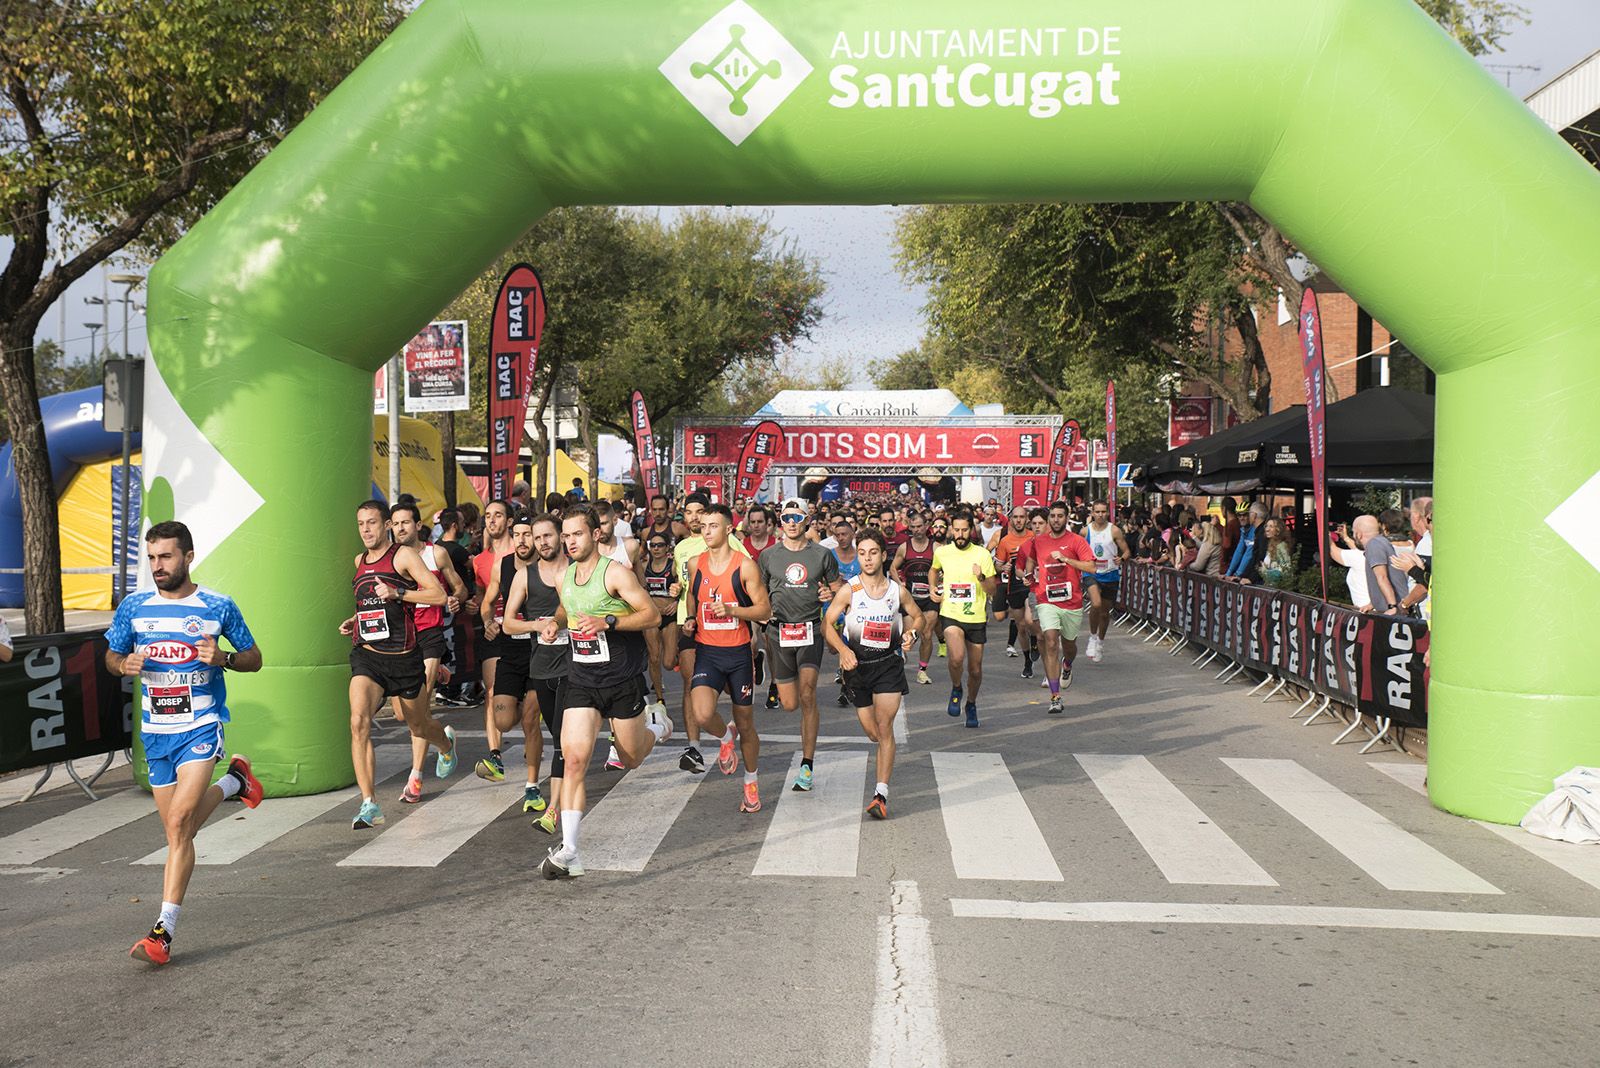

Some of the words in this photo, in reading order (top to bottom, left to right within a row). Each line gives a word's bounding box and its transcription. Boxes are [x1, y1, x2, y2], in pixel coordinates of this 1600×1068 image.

[829, 27, 1067, 59] AJUNTAMENT
[1076, 26, 1122, 55] DE
[827, 62, 1121, 118] SantCugat
[508, 290, 523, 338] RAC
[498, 355, 511, 399] RAC
[836, 402, 919, 416] CaixaBank
[694, 434, 706, 456] RAC
[756, 434, 768, 454] RAC
[784, 432, 853, 458] TOTS
[863, 432, 926, 459] SOM
[936, 433, 953, 458] 1
[1020, 434, 1032, 457] RAC
[1024, 481, 1033, 495] RAC
[1250, 596, 1260, 660] RAC
[1289, 603, 1299, 675] RAC
[149, 645, 188, 659] DANI
[1324, 612, 1339, 689] RAC
[1345, 615, 1358, 697] RAC
[1387, 622, 1414, 710] RAC
[24, 646, 66, 751] RAC
[66, 640, 101, 741] 1
[156, 697, 183, 707] JOSEP
